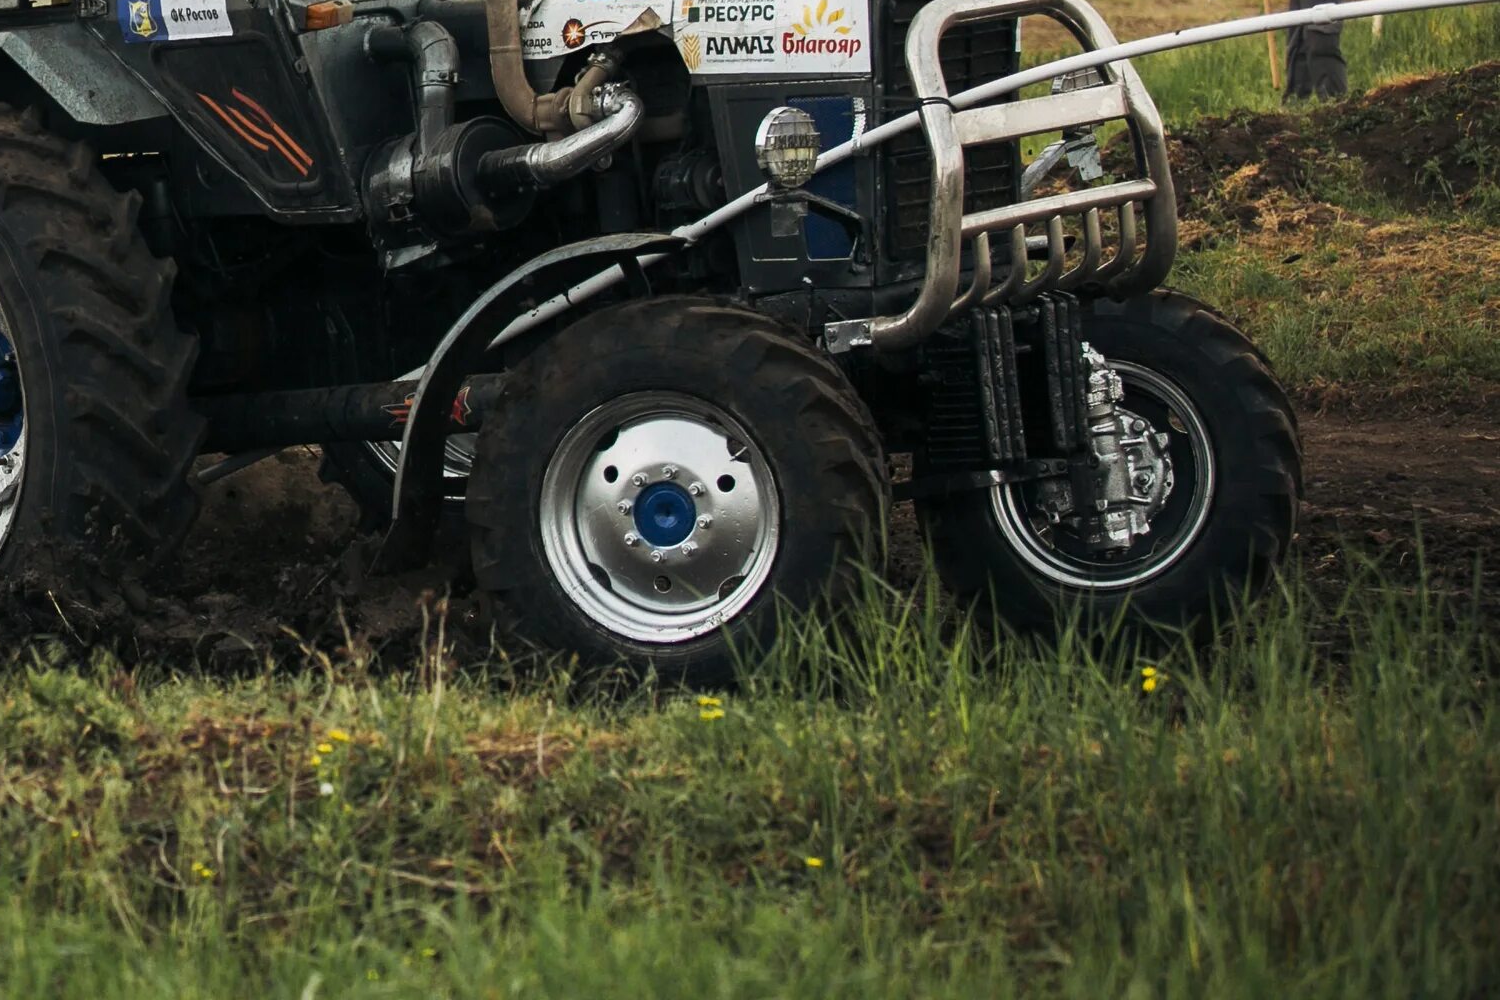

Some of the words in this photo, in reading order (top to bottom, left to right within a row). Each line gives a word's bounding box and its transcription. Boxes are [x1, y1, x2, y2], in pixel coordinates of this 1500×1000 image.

[170, 8, 186, 23] ФК
[186, 7, 219, 21] Ростов
[704, 4, 775, 23] РЕСУРС
[705, 35, 775, 56] АЛМАЗ
